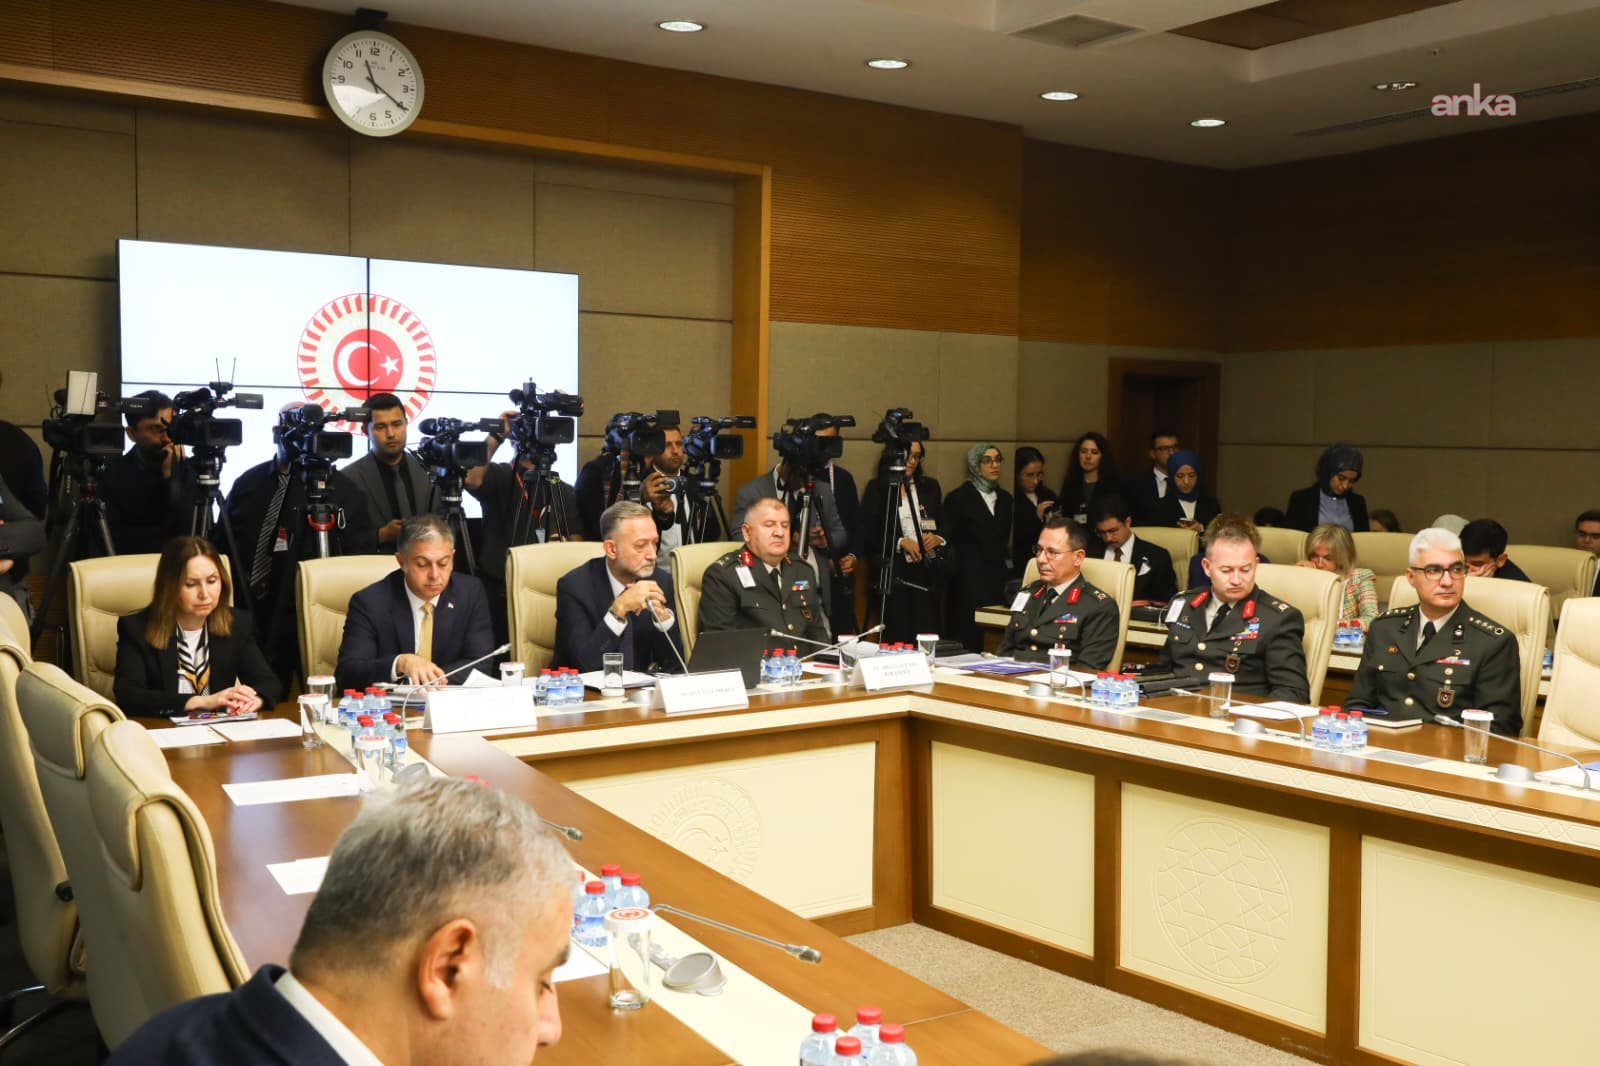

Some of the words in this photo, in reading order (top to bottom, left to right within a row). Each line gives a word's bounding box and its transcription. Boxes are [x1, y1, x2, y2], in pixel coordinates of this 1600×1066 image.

[356, 50, 362, 58] 11
[370, 47, 380, 57] 12
[343, 60, 353, 69] 10
[398, 68, 405, 77] 2
[338, 75, 345, 83] 9
[402, 84, 409, 93] 3
[369, 112, 377, 121] 6
[384, 110, 392, 119] 5
